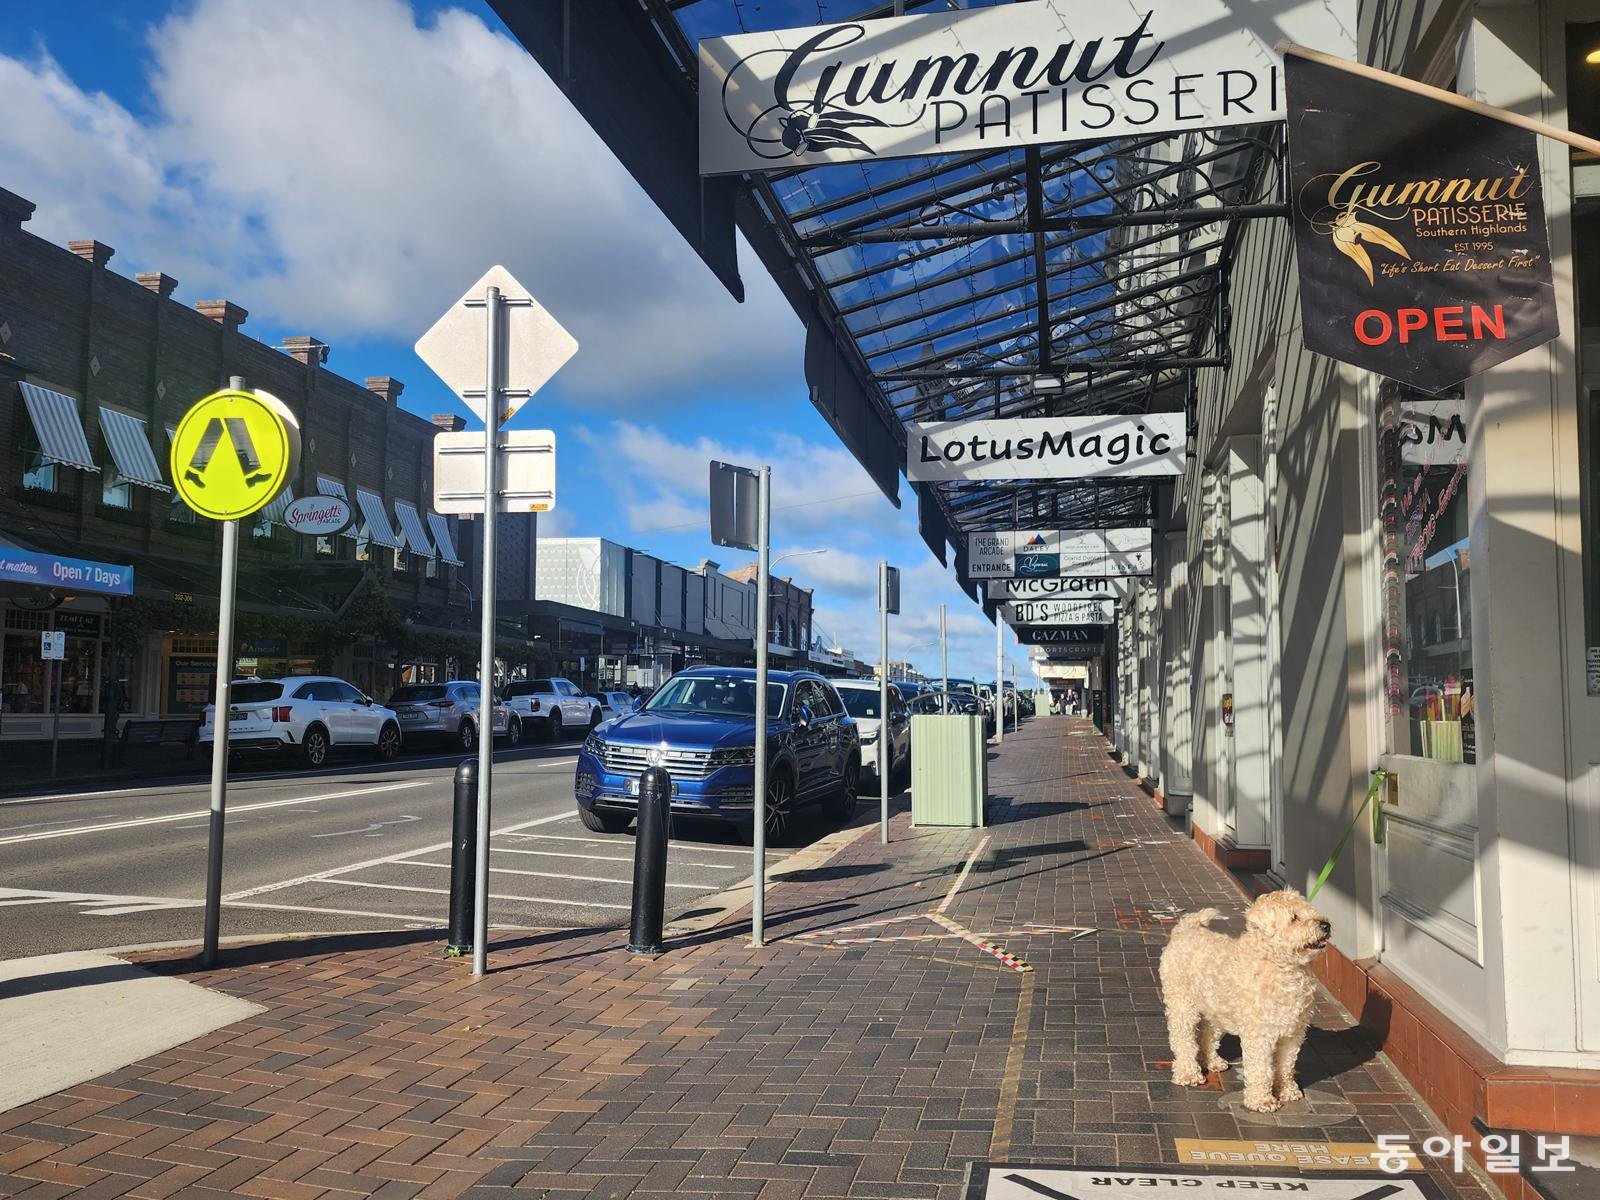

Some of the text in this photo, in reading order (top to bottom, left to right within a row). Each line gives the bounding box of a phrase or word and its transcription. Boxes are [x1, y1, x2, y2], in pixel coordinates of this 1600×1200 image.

[723, 10, 1166, 128] Gumnut
[930, 66, 1278, 145] PATISSERI
[1299, 161, 1535, 222] Gumnut
[1413, 203, 1528, 226] PATISSERIE
[1416, 223, 1528, 238] Southern Highlands
[1455, 242, 1494, 252] EST 1995
[1411, 261, 1440, 273] Short
[1443, 259, 1460, 272] Eat
[1464, 257, 1504, 272] Dessert
[1508, 255, 1541, 269] First"
[1354, 304, 1507, 346] OPEN
[920, 425, 1172, 466] LotusMagic
[975, 537, 1010, 547] THE GRAND
[979, 547, 1004, 556] ARCADE
[6, 561, 38, 575] matters
[53, 561, 82, 581] Open
[85, 566, 93, 581] 7
[94, 567, 121, 587] Days
[972, 563, 1012, 573] ENTRANCE
[1005, 578, 1108, 593] McGrath
[1016, 603, 1048, 622] BD'S
[1053, 602, 1103, 612] WOODFIRED
[1053, 612, 1073, 622] PIZZA
[1081, 612, 1104, 622] PASTA
[1032, 630, 1089, 641] GAZMAN
[1253, 1142, 1330, 1154] HERE
[1190, 1150, 1288, 1162] QUEUE
[1090, 1177, 1310, 1192] KEEP CLEAR
